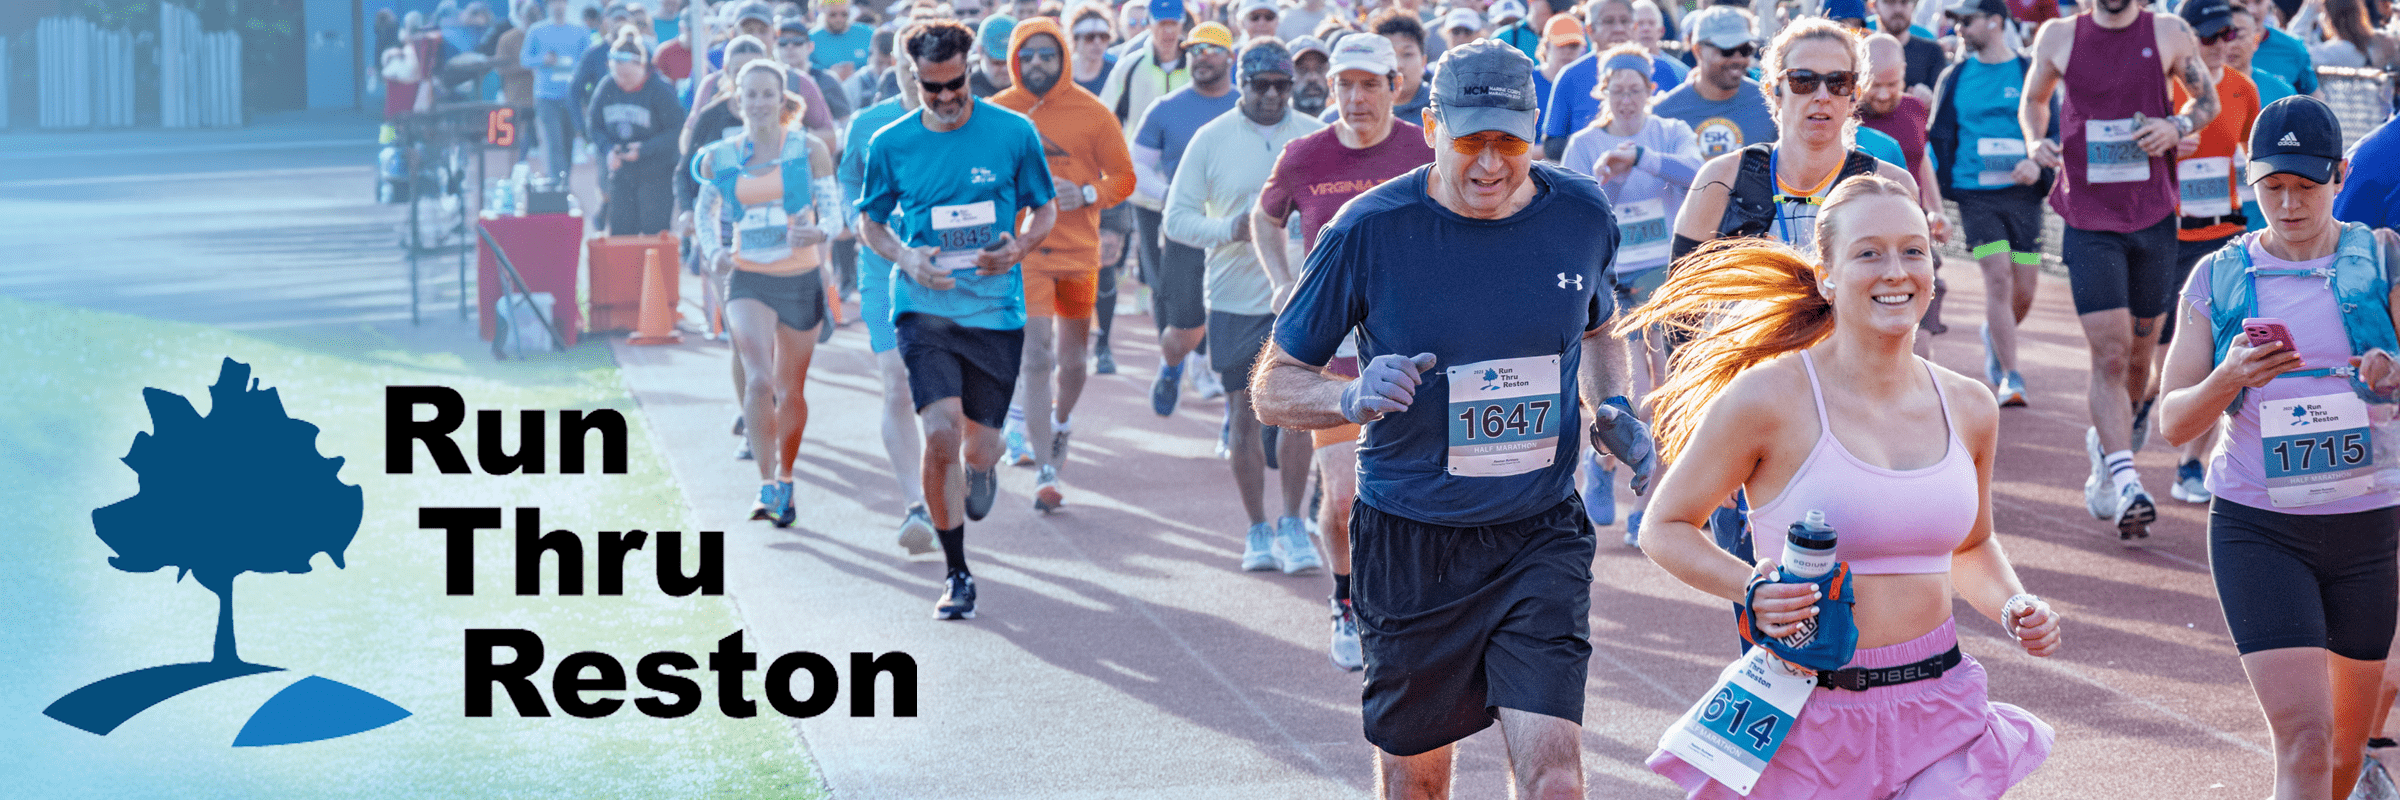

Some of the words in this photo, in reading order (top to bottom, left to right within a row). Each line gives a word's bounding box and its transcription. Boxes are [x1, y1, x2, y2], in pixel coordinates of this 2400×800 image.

[1464, 86, 1489, 96] MCM
[488, 108, 514, 146] 15
[1705, 131, 1729, 142] 5K
[1308, 180, 1375, 196] VIRGINIA
[942, 226, 991, 248] 1845
[1459, 400, 1552, 440] 1647
[1474, 446, 1494, 454] HALF
[1496, 442, 1537, 452] MARATHON
[2273, 433, 2365, 472] 1715
[2290, 476, 2308, 484] HALF
[2312, 472, 2352, 482] MARATHON
[1794, 559, 1827, 568] PODIUM
[1749, 661, 1764, 675] Thru
[1745, 670, 1772, 688] Reston
[1700, 728, 1742, 758] MARATHON
